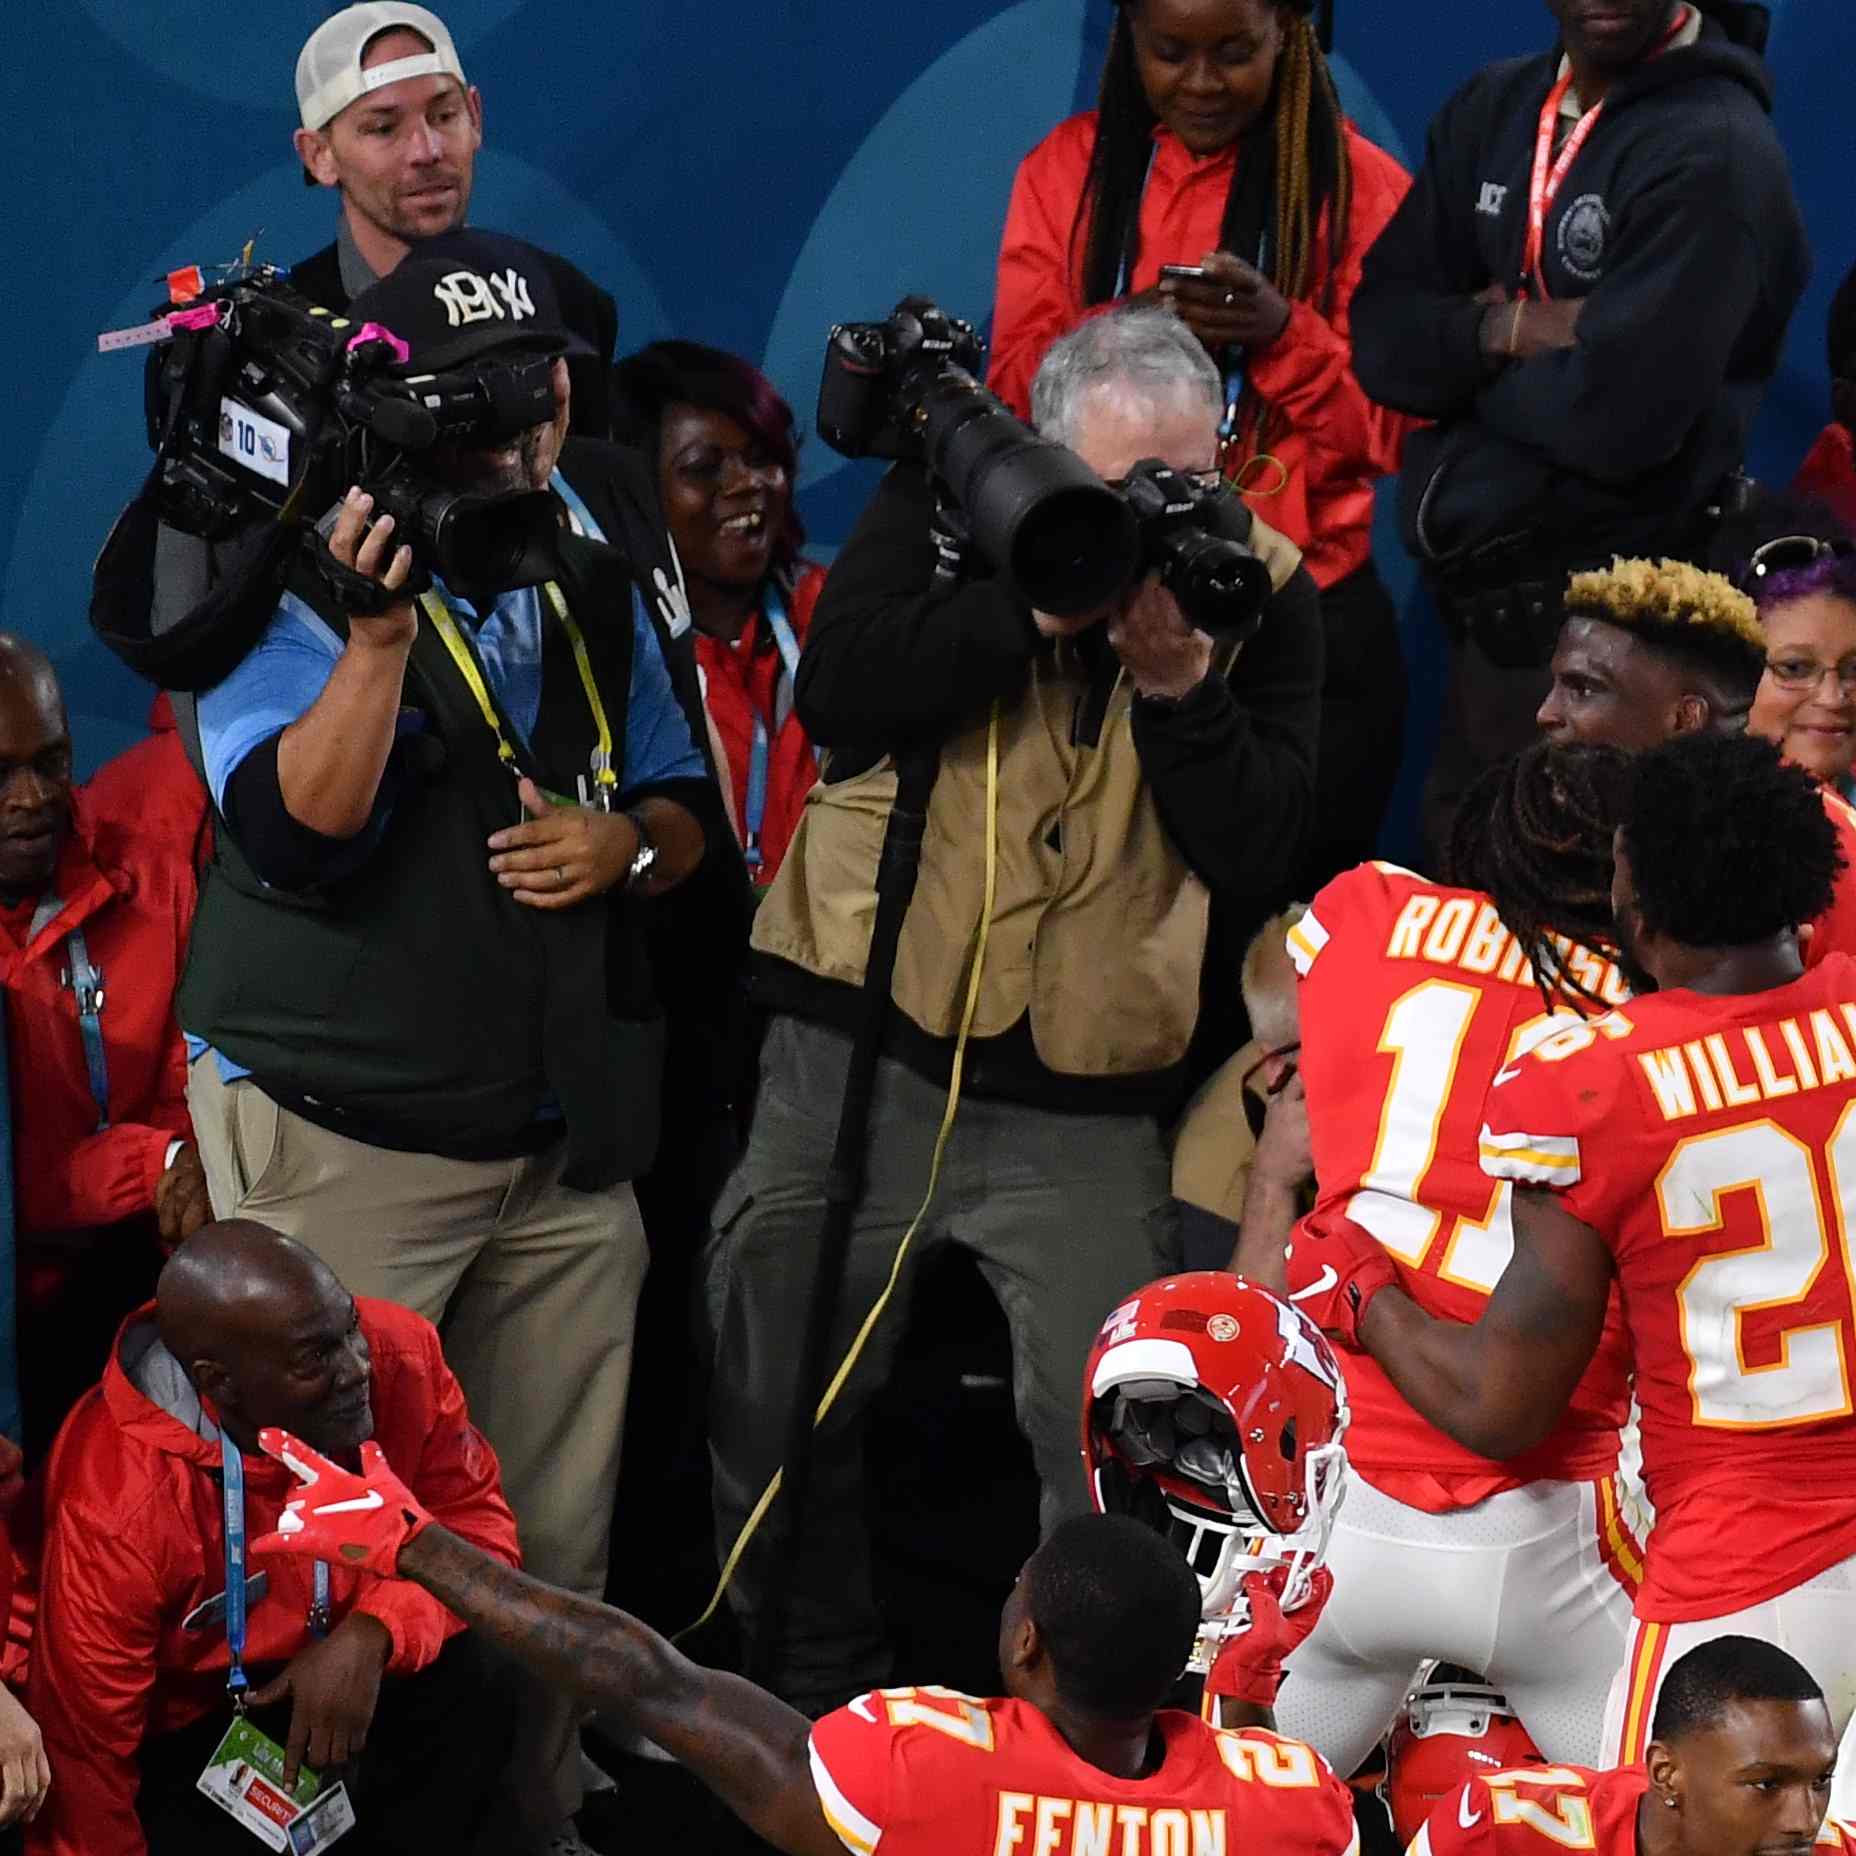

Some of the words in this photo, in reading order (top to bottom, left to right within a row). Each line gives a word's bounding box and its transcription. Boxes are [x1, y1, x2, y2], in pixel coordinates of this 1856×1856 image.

[237, 419, 256, 457] 10
[248, 1785, 294, 1823] SECURIT
[1478, 1765, 1597, 1850] 17
